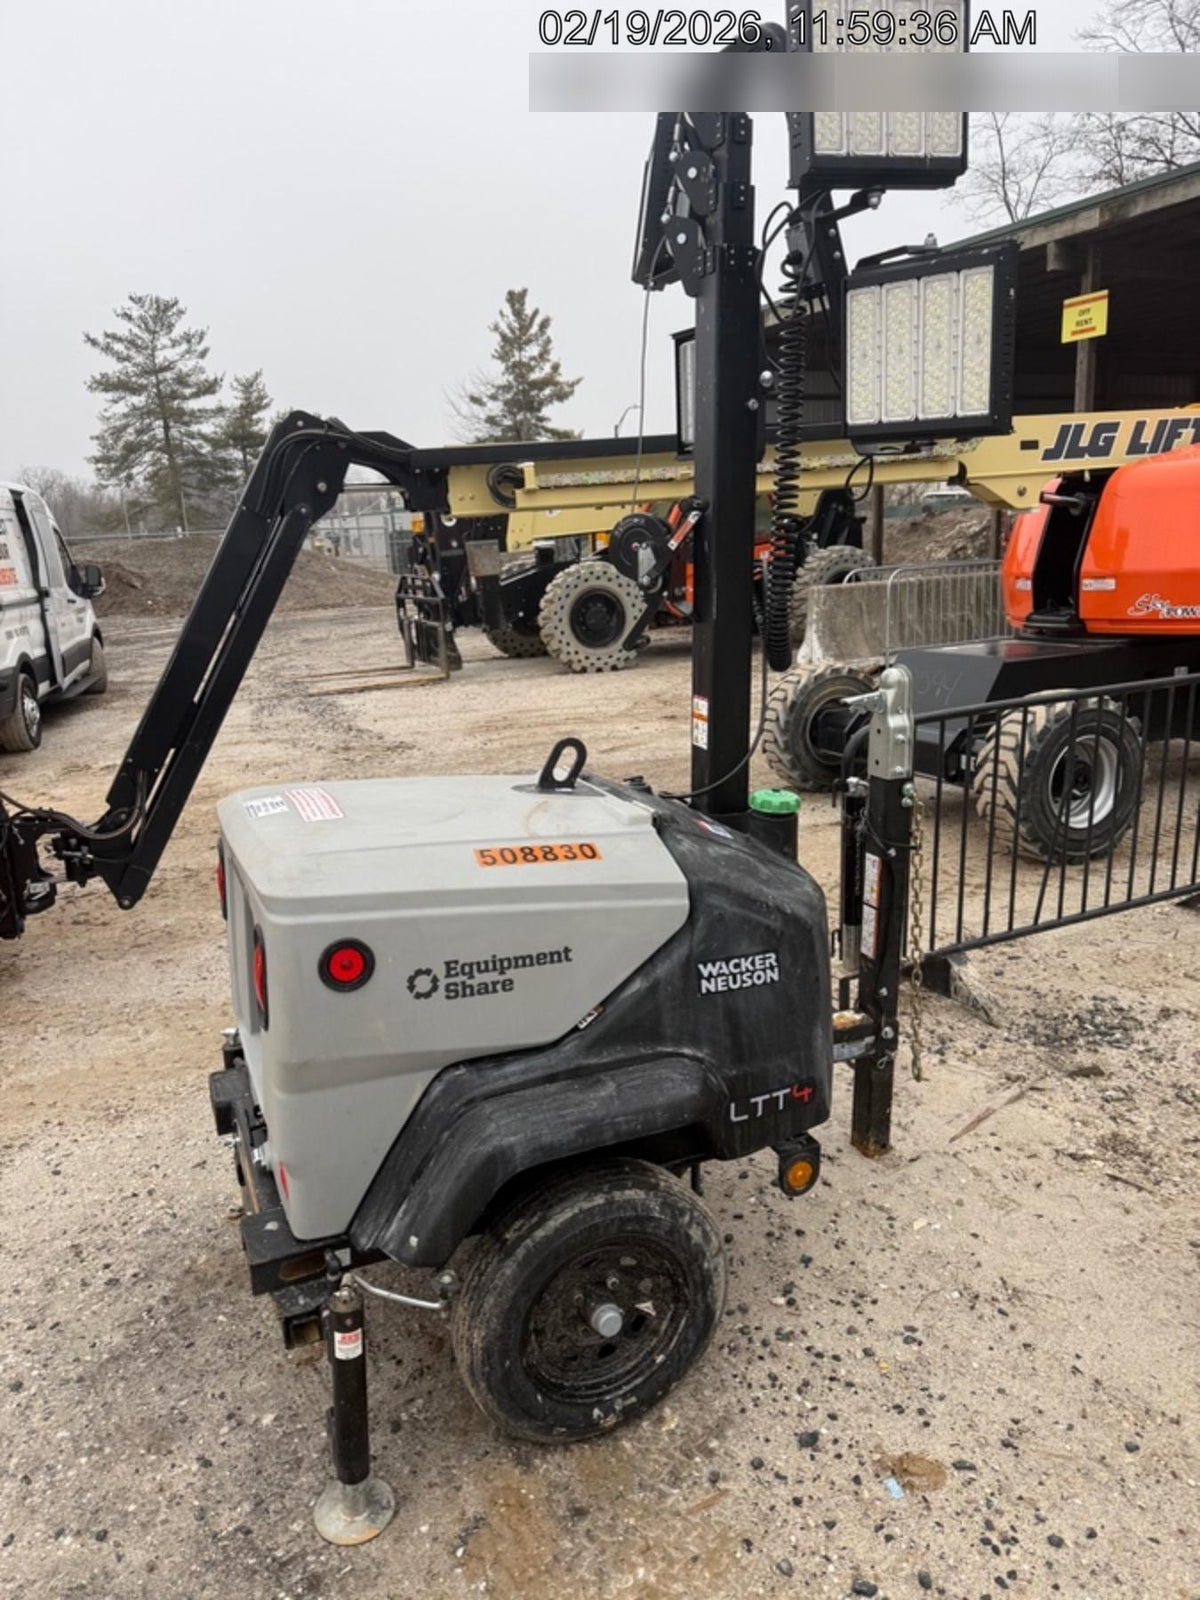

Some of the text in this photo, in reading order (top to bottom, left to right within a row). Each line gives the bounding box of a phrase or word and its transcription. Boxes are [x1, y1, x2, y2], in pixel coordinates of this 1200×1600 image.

[1040, 420, 1122, 462] JLG
[478, 842, 598, 867] 508830
[443, 946, 573, 980] Equipment
[697, 952, 778, 978] WACKER
[444, 977, 515, 1001] Share
[700, 967, 780, 995] NEUSON
[729, 1084, 812, 1122] LTT4
